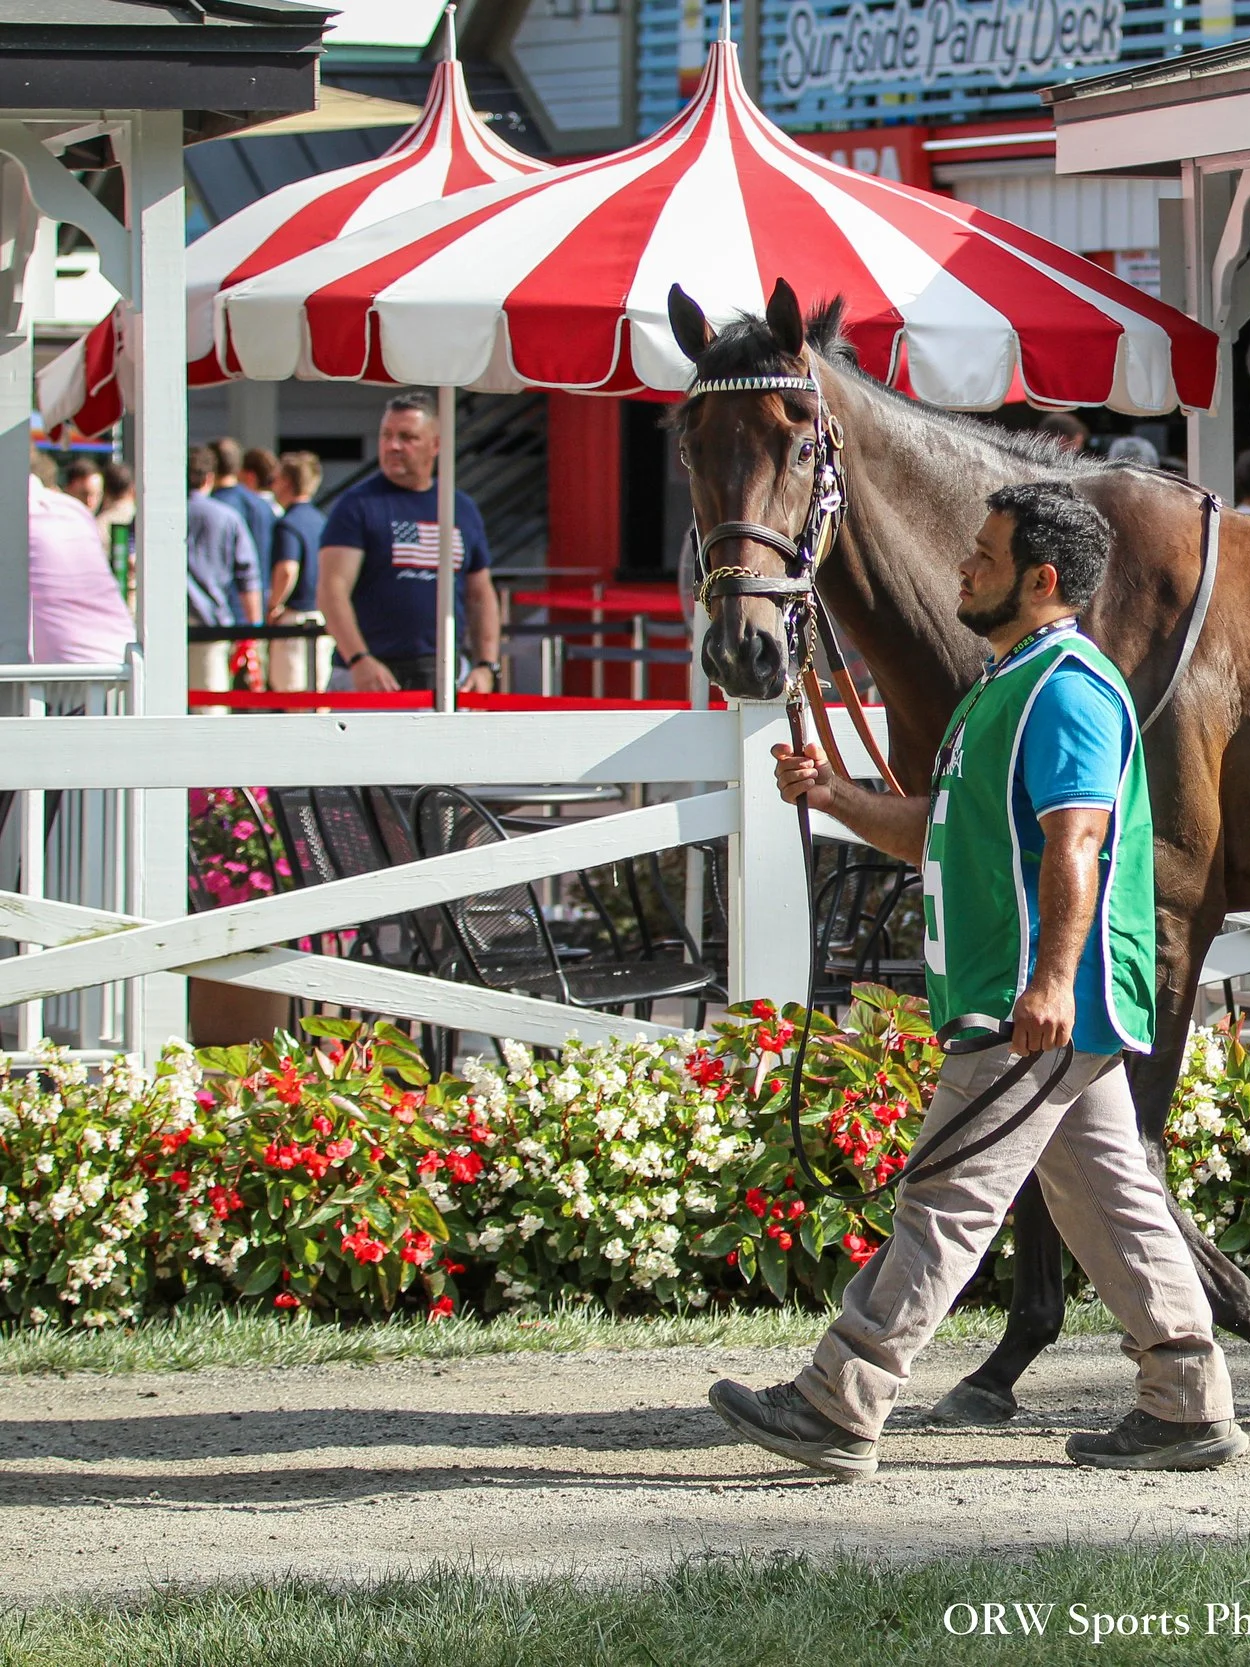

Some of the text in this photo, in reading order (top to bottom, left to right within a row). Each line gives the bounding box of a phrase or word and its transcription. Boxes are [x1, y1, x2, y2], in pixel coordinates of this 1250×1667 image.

[781, 0, 1117, 89] Surfside Party Deck
[1012, 635, 1036, 655] 2025
